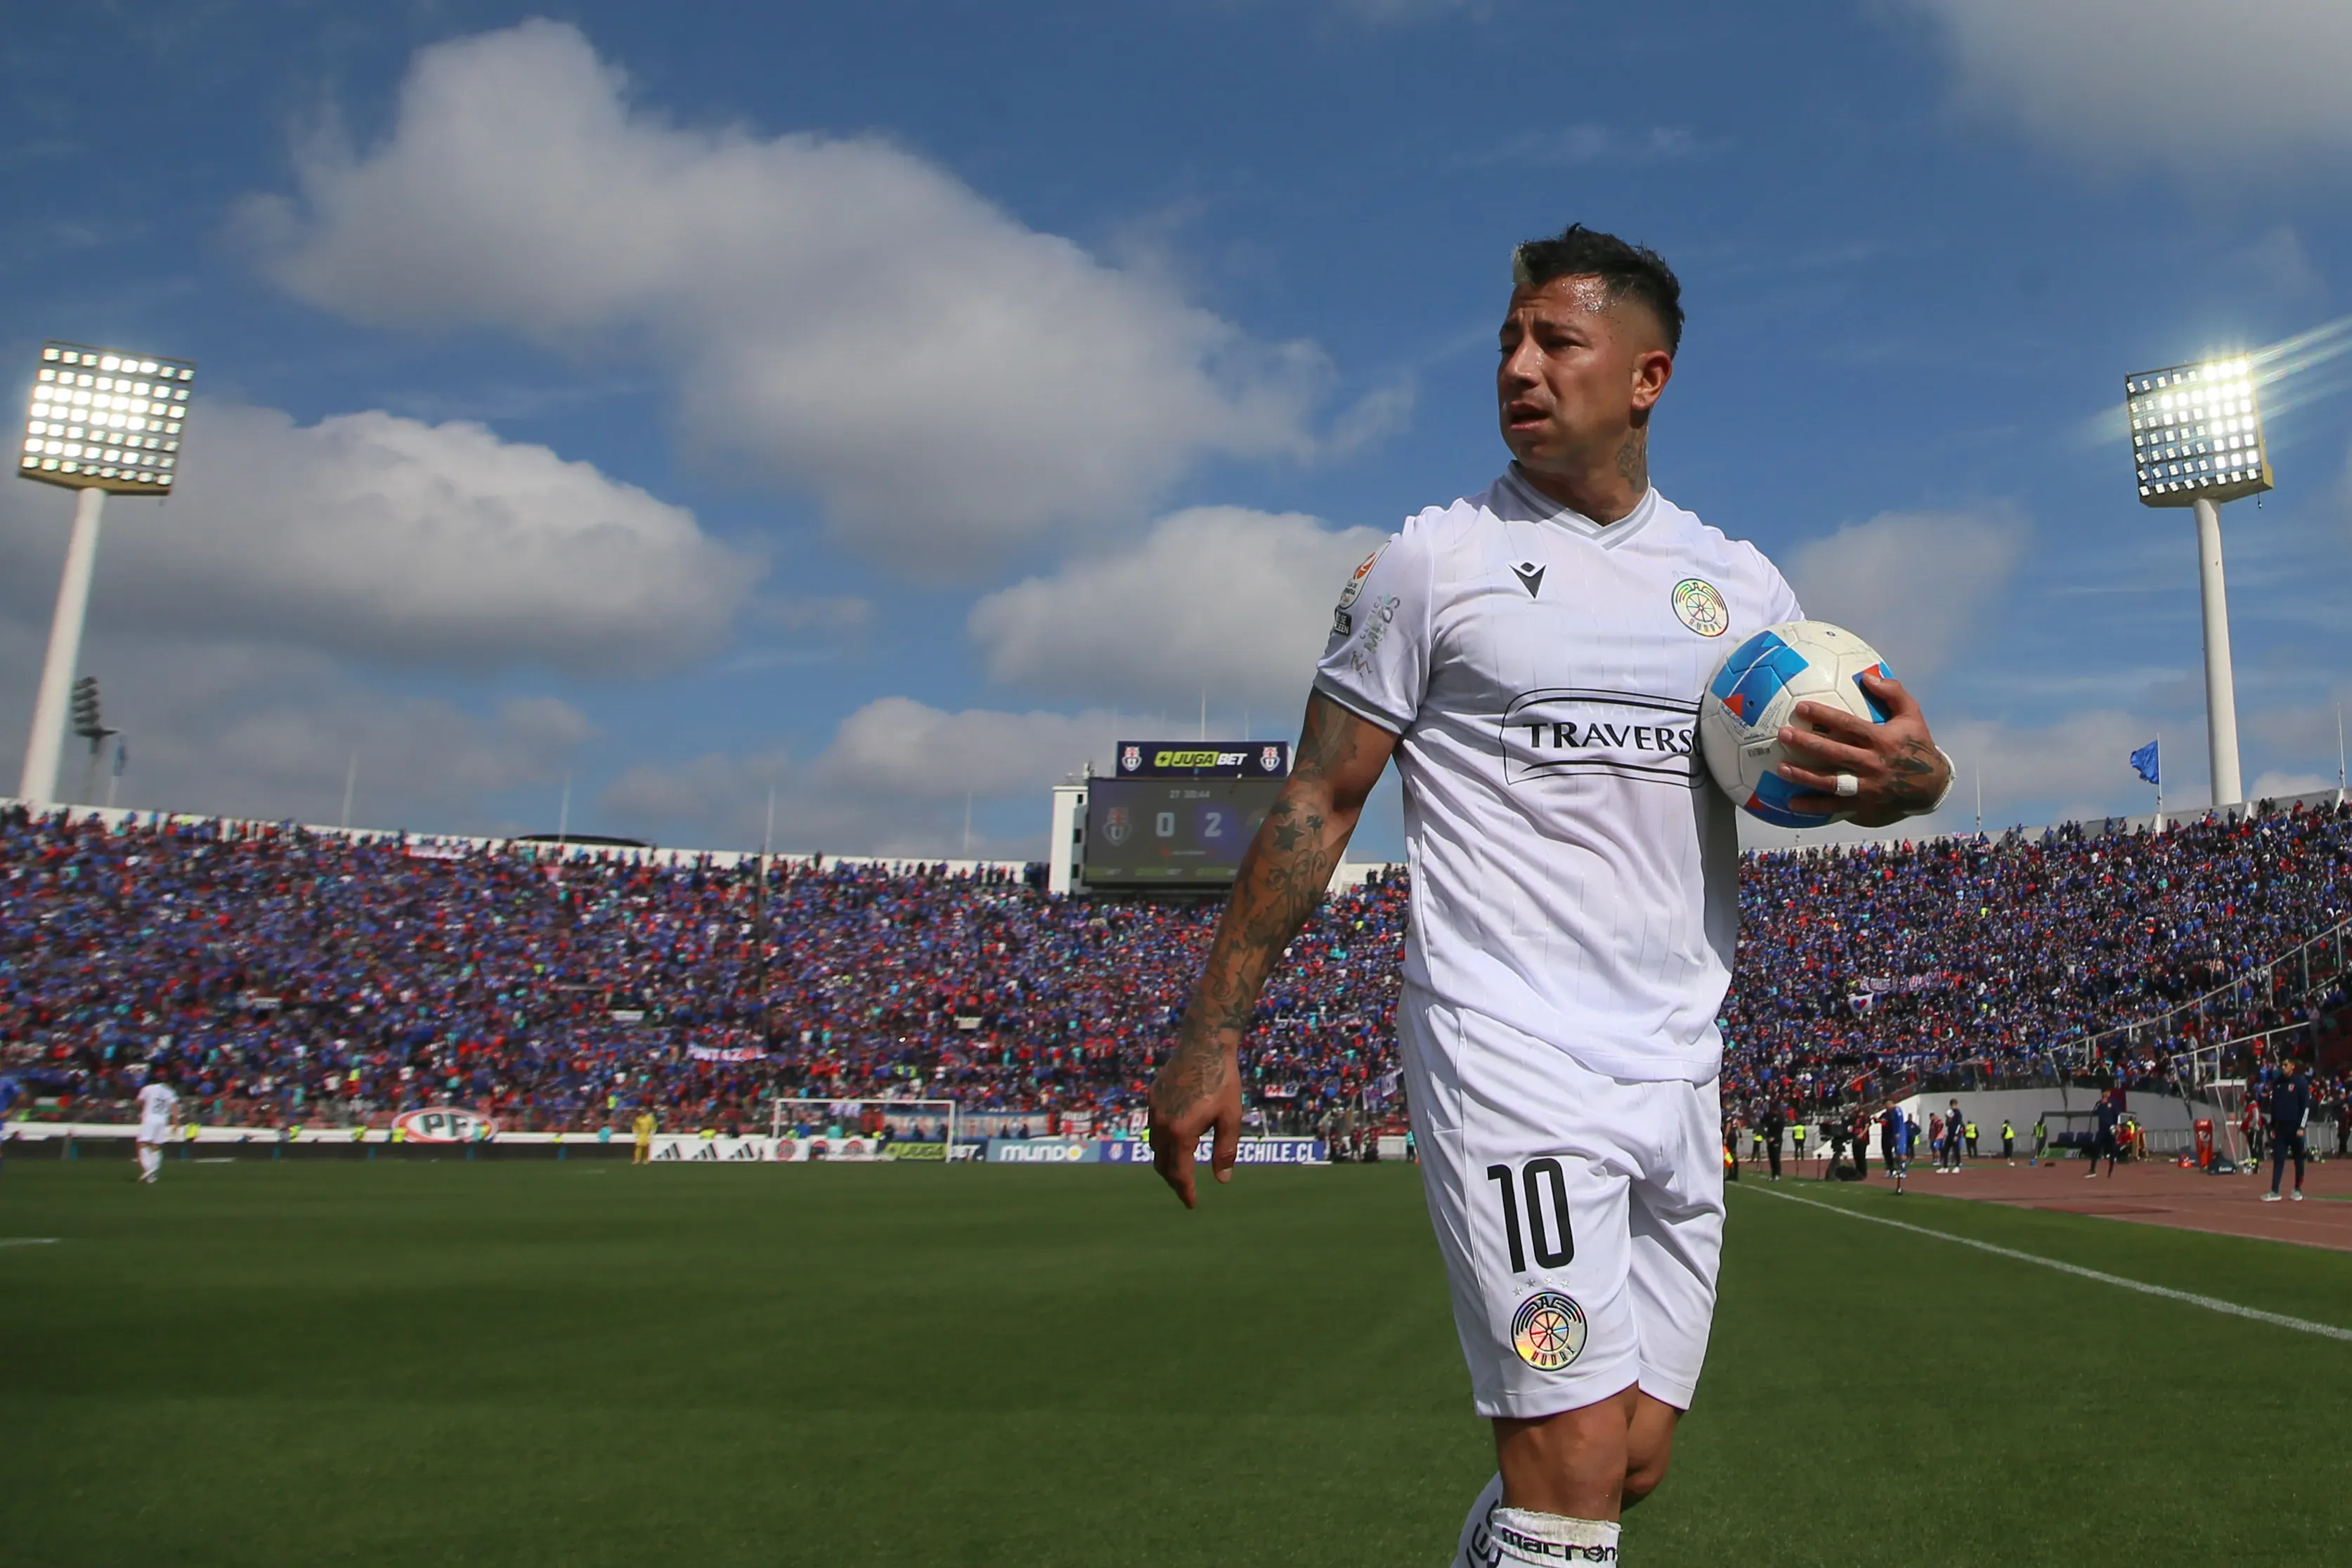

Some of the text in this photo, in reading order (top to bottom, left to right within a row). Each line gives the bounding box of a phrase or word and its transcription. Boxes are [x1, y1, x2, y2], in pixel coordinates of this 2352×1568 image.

[1523, 721, 1699, 757] TRAVERS
[1174, 752, 1248, 766] JUGABET
[1156, 812, 1222, 837] 0 2
[1486, 1157, 1575, 1274] 10
[1501, 1527, 1618, 1562] macron
